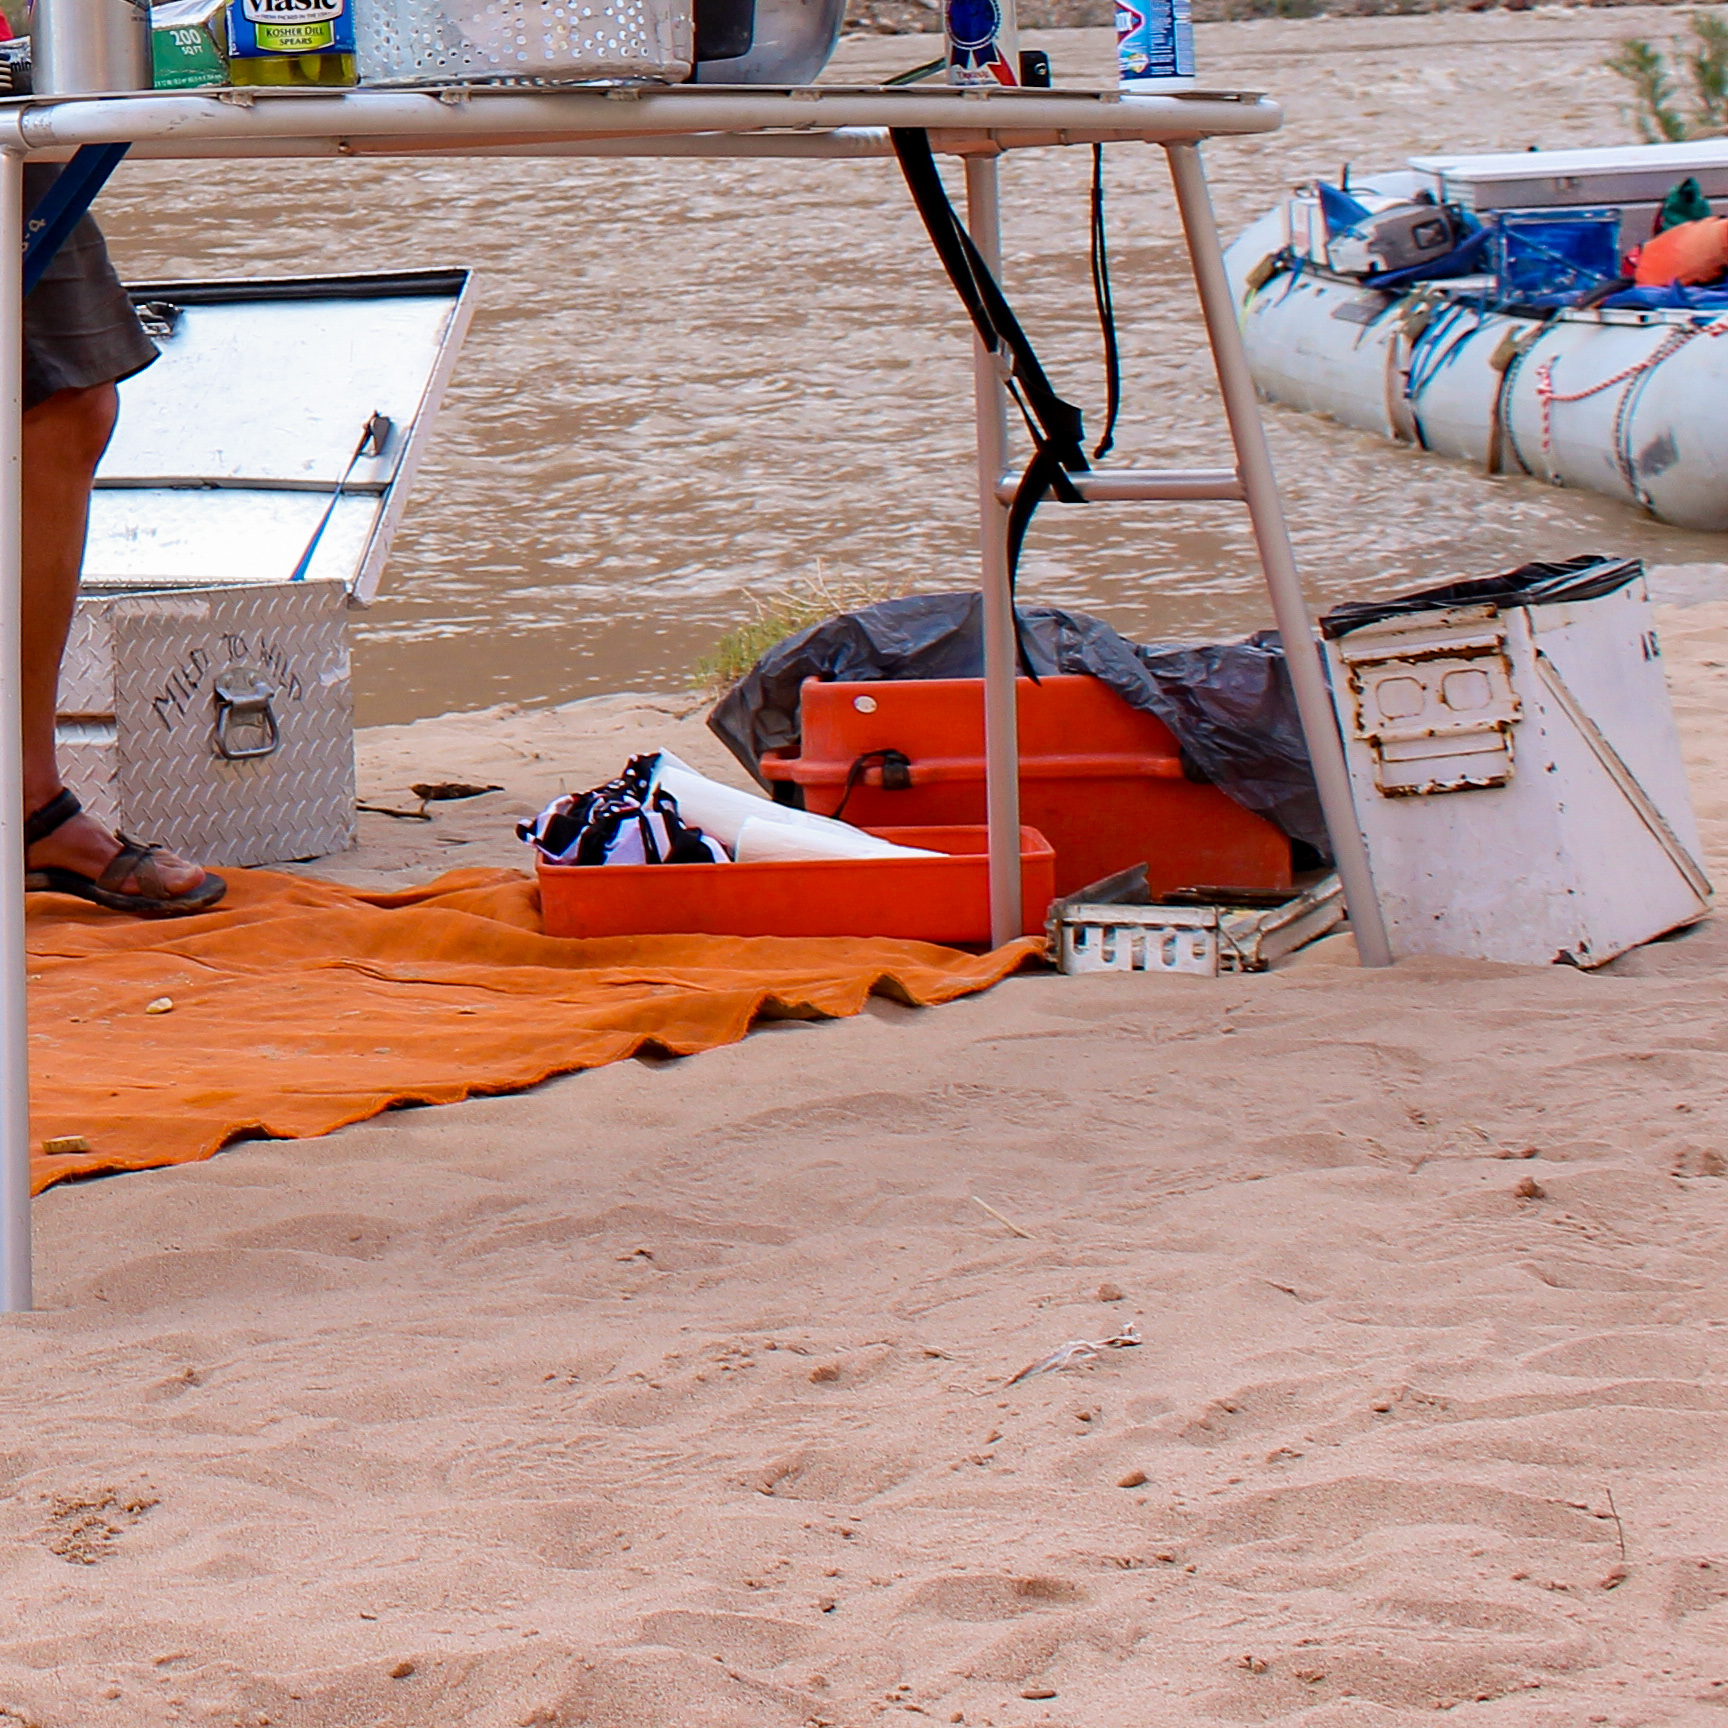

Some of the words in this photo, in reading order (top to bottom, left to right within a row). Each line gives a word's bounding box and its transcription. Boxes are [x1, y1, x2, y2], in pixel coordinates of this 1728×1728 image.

[169, 28, 202, 46] 200
[266, 27, 302, 38] KOSHER
[305, 25, 324, 36] DILL
[279, 37, 313, 47] SPEARS
[151, 648, 210, 733] MILD
[218, 631, 248, 664] TO
